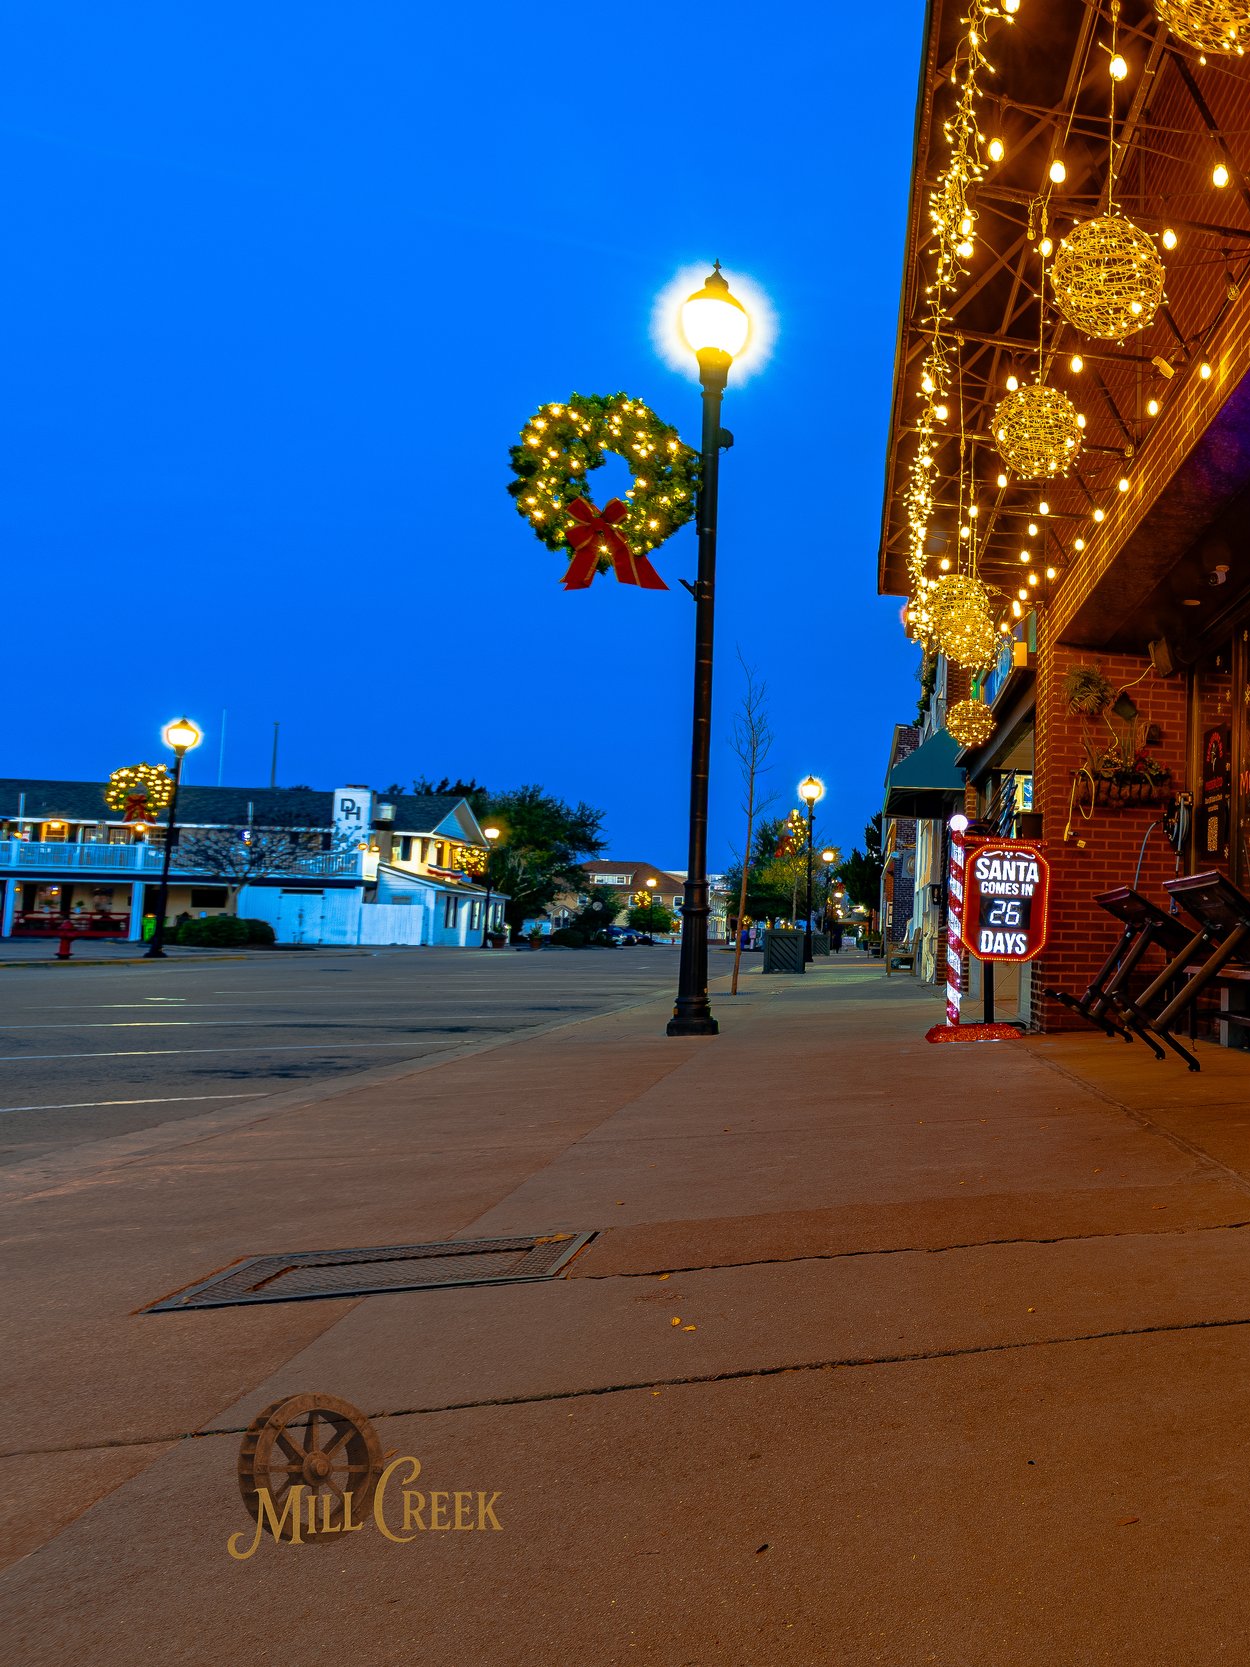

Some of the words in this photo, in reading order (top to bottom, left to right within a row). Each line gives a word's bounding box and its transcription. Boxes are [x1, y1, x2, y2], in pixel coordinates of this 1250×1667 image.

[975, 857, 1039, 883] SANTA
[981, 881, 1019, 895] COMES
[1021, 883, 1034, 896] IN
[989, 900, 1021, 925] 26
[980, 930, 1027, 955] DAYS
